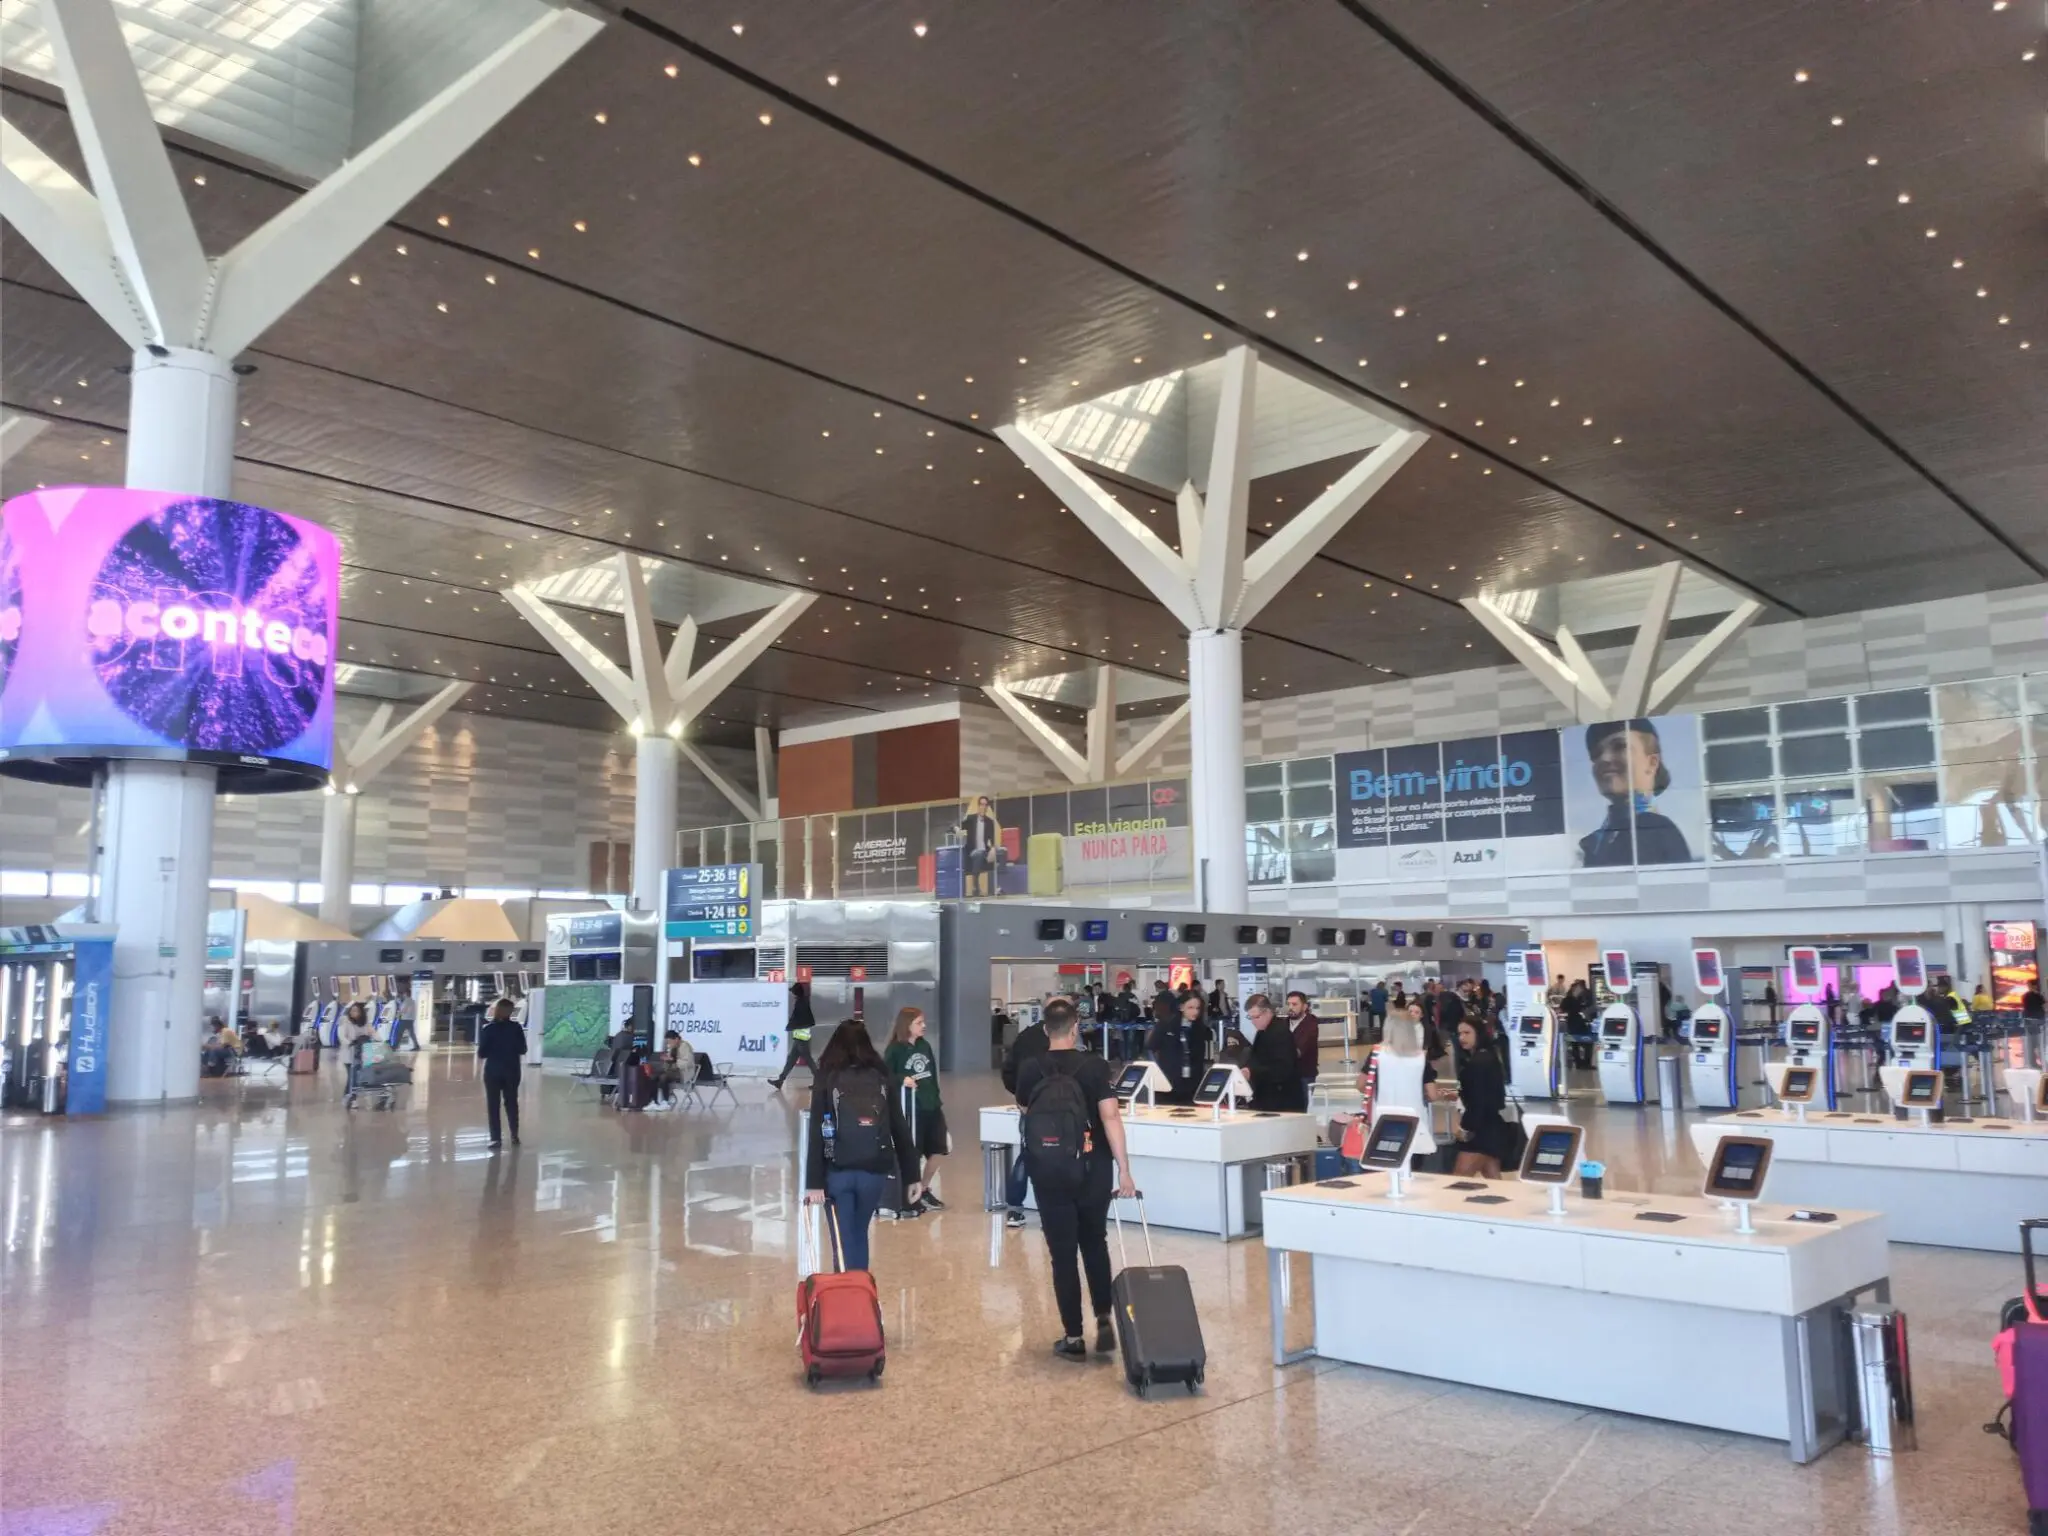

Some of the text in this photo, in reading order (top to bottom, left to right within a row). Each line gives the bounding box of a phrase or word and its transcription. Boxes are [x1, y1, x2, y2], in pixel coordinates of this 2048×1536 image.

[1350, 754, 1532, 801] Bem-vindo
[1352, 806, 1372, 816] Você
[1352, 817, 1363, 825] do
[1395, 814, 1414, 822] com
[1074, 817, 1167, 837] Esta viagem
[1352, 826, 1363, 834] da
[852, 837, 907, 851] AMERICAN
[1082, 834, 1168, 860] NUNCA PARA
[852, 847, 906, 859] TOURISTER
[1453, 850, 1482, 864] Azul
[697, 868, 726, 883] 25-36
[704, 905, 725, 919] 1-24
[668, 1002, 695, 1015] CADA
[79, 983, 99, 1052] Hudson
[670, 1020, 722, 1033] DO BRASIL
[739, 1035, 766, 1052] Azul
